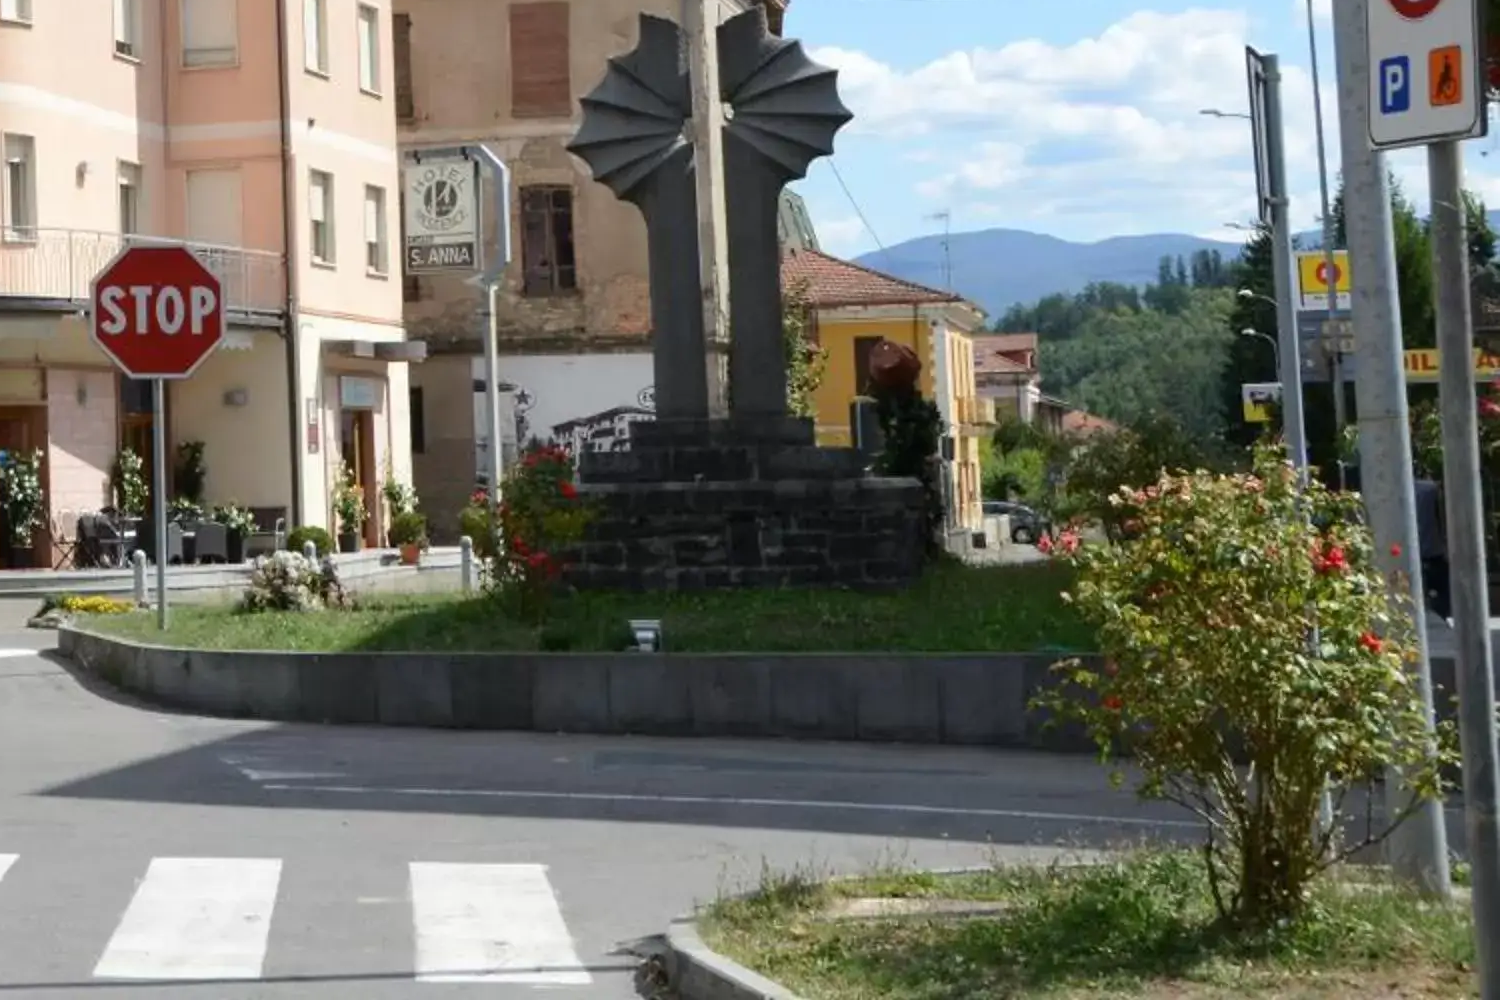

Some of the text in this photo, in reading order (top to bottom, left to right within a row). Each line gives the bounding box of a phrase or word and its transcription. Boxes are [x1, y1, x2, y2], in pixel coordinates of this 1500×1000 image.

[1385, 65, 1404, 107] P
[412, 167, 468, 193] HOTEL
[428, 247, 471, 265] ANNA
[100, 285, 217, 335] STOP
